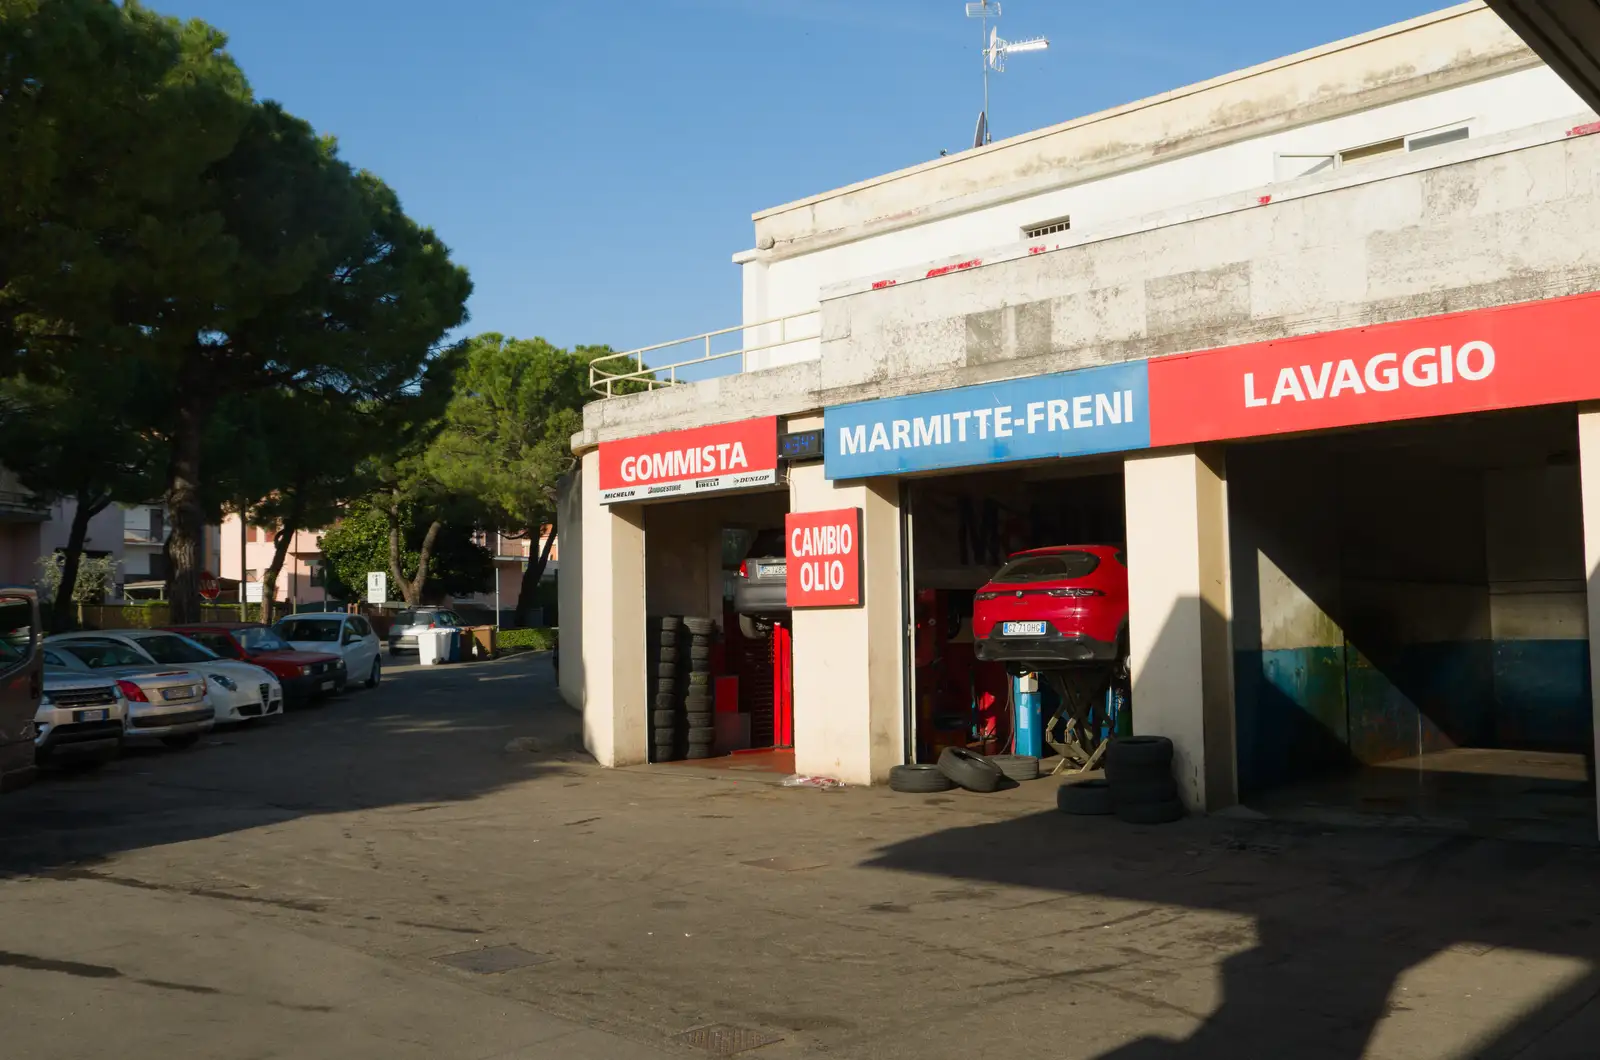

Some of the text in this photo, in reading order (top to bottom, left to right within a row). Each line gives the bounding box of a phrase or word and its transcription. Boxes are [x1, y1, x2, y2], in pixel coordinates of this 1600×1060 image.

[1244, 340, 1495, 408] LAVAGGIO
[839, 390, 1134, 456] MARMITTE-FRENI
[620, 441, 748, 482] GOMMISTA
[604, 490, 636, 499] MICHELIN
[696, 478, 719, 488] PIRELLI
[740, 475, 770, 483] DUNLOP
[791, 524, 852, 557] CAMBIO
[800, 560, 844, 592] OLIO
